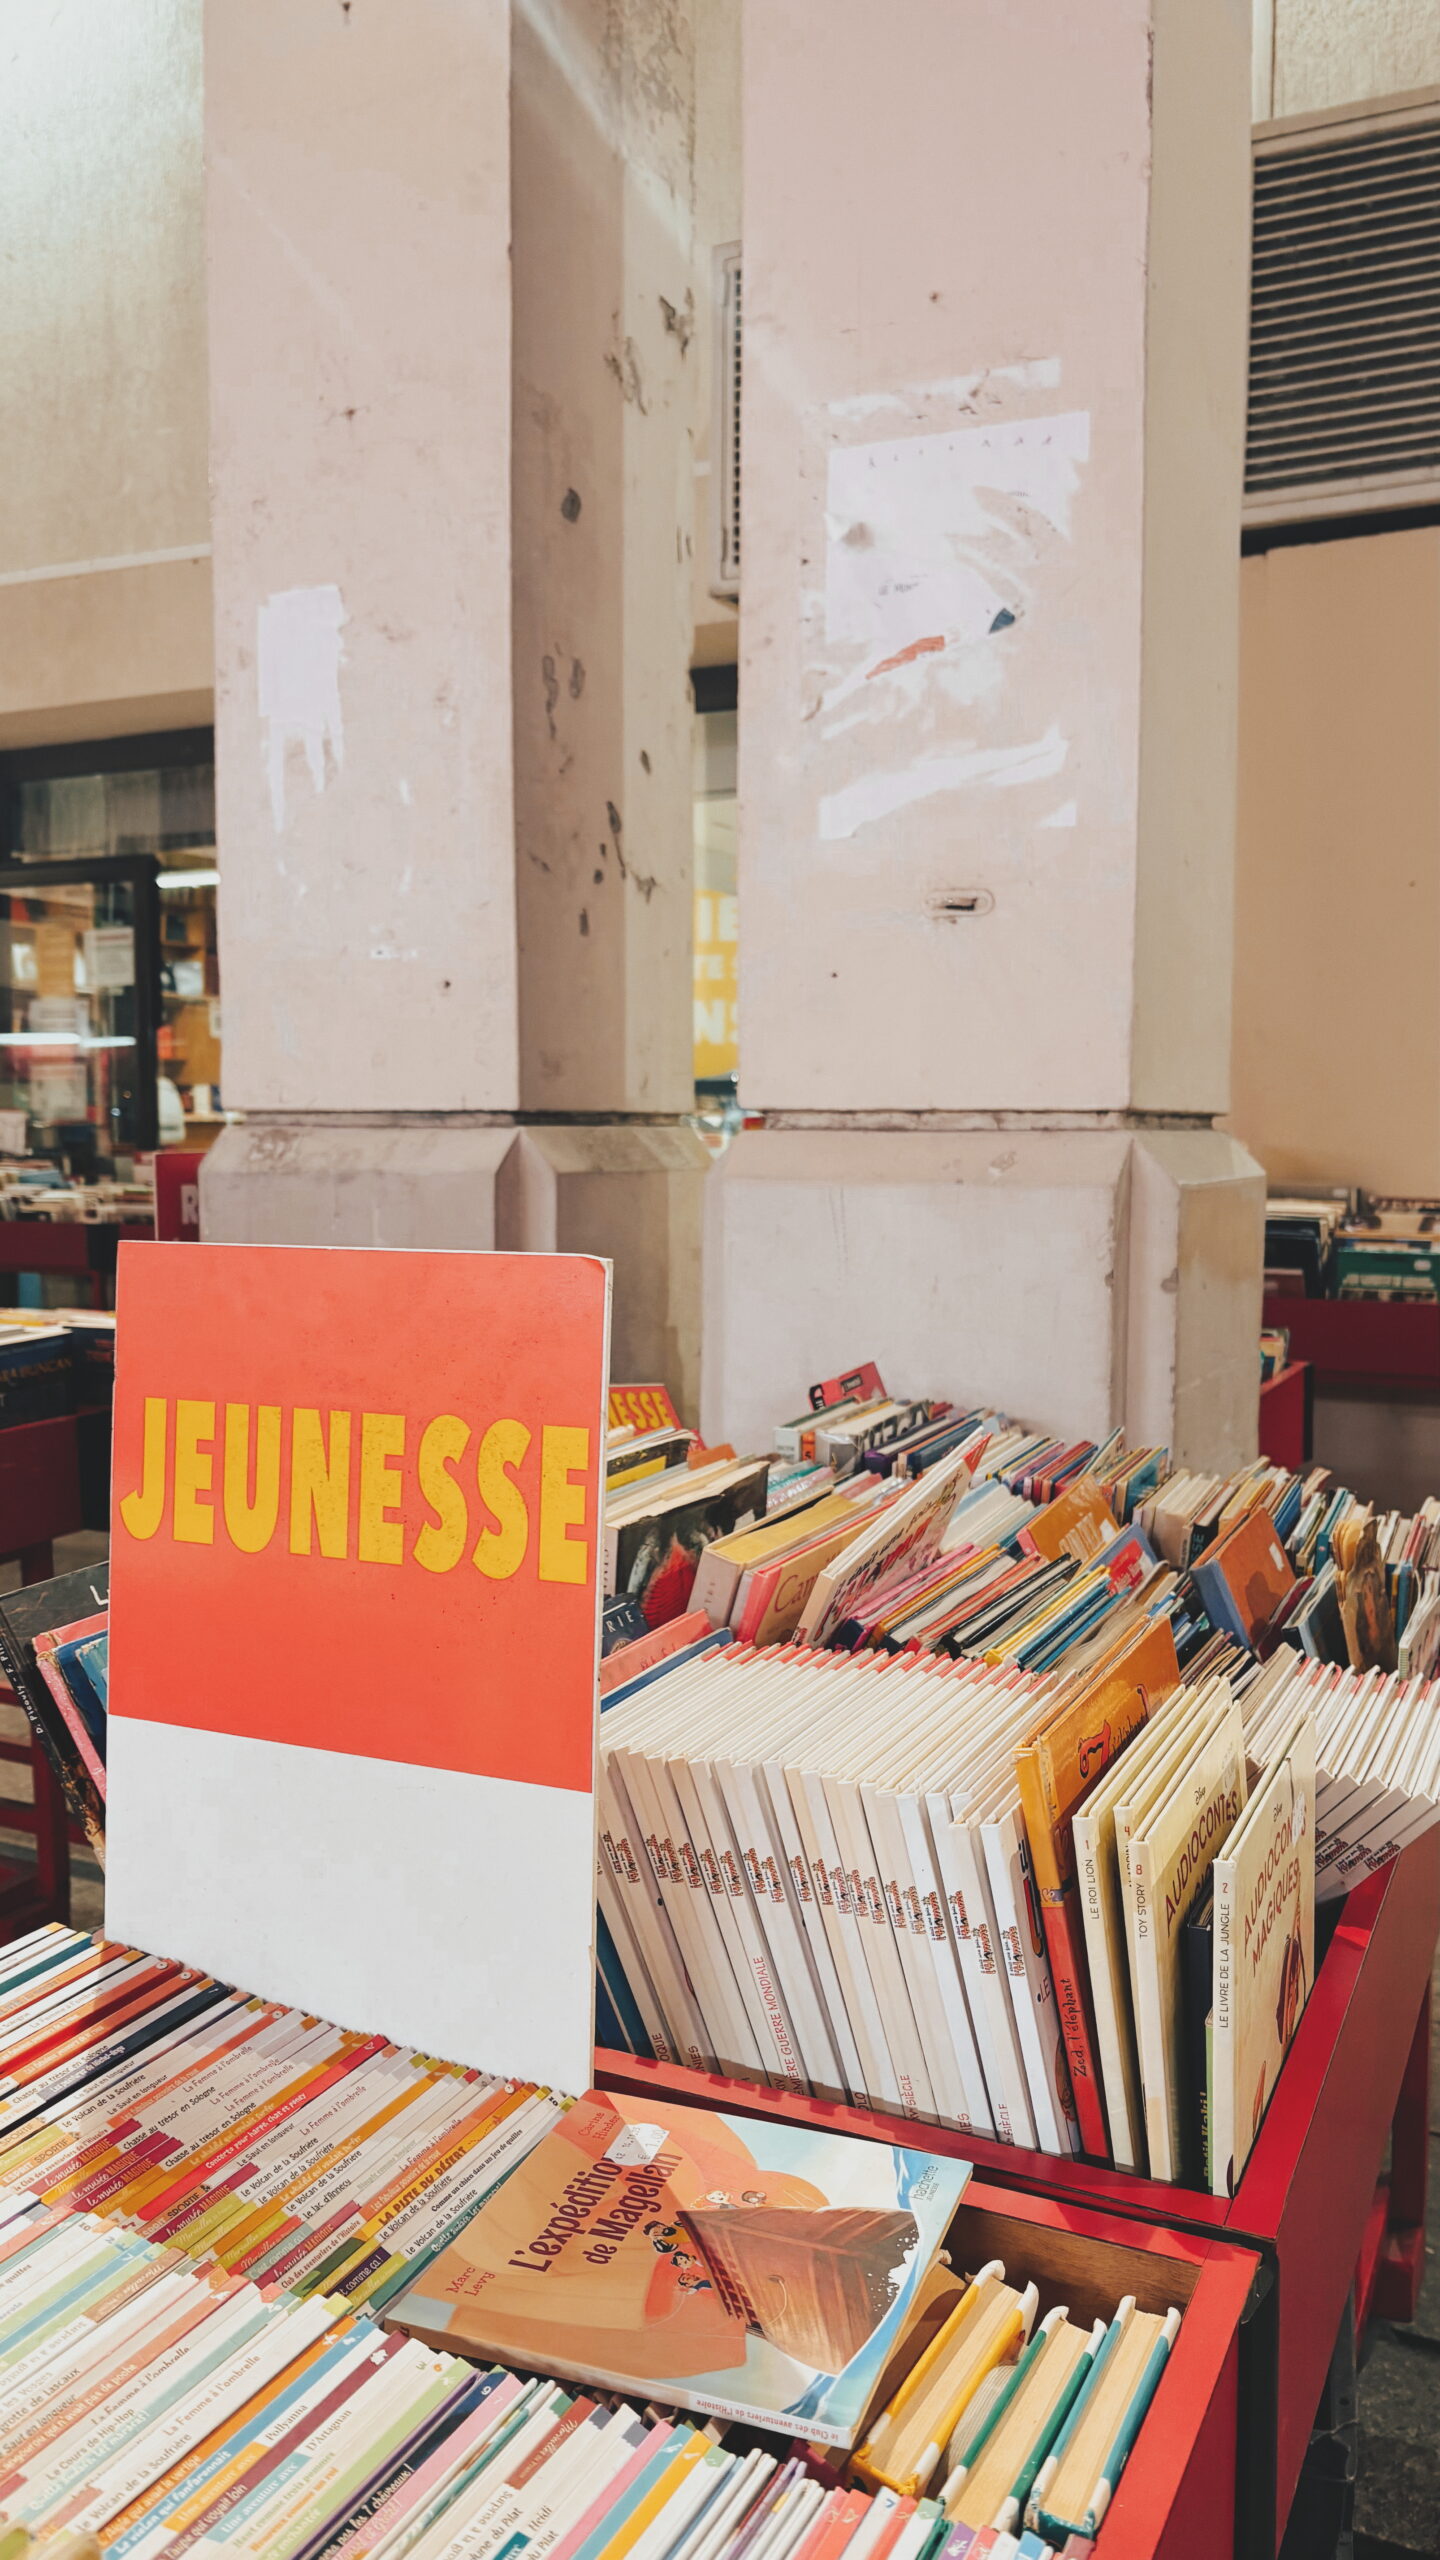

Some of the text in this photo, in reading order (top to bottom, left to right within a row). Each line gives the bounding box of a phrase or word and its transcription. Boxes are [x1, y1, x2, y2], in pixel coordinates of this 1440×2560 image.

[120, 1397, 590, 1585] JEUNESSE
[1085, 1859, 1096, 1883] LION
[1165, 1790, 1238, 1938] AUDIOCONTES
[1244, 1806, 1306, 1957] AUDIOCONS
[1088, 1883, 1099, 1905] ROI
[1091, 1907, 1100, 1920] LE
[1135, 1864, 1148, 1939] TOY STORY 8
[1252, 1857, 1301, 1978] MAGIQUES
[1219, 1882, 1231, 2029] LE LIVRE DE LA JUNGLE 2
[753, 1955, 780, 2011] MONDIALE
[770, 2013, 793, 2056] GUERRE
[182, 2043, 252, 2093] La Femme à l'ombrelle
[61, 2071, 145, 2128] Le Volcan de la Soufrière
[107, 2105, 117, 2115] Le
[116, 2096, 132, 2109] Saut
[140, 2073, 168, 2095] longueur
[164, 2100, 257, 2167] Chasse au trésor en Sologne
[205, 2093, 307, 2169] Concerto pour harpe, chat et poney
[578, 2112, 605, 2137] Carine
[34, 2137, 69, 2163] SPORTIF
[240, 2136, 319, 2197] Le Volcan de la Soufrière
[430, 2127, 524, 2212] Comme un chien dans un jeu de quilles
[94, 2177, 124, 2201] musée
[120, 2157, 154, 2183] MAGIQUE
[302, 2177, 352, 2219] Le lac d'Annecy
[378, 2145, 466, 2226] LA PISTE DU DÉSERT
[588, 2152, 684, 2243] Magellan
[911, 2165, 939, 2201] hachette
[405, 2187, 477, 2255] Le Volcan de la Soufrière
[280, 2218, 360, 2288] Club des aventuriers de l'Histoire
[583, 2243, 618, 2265] de
[445, 2265, 476, 2293] Marc
[464, 2271, 497, 2297] Levy
[28, 2393, 44, 2408] de
[43, 2365, 80, 2396] Lascaux
[163, 2352, 260, 2438] La Femme à l'ombrelle
[697, 2399, 733, 2416] l'Histoire
[46, 2406, 136, 2481] Le Cours de Hip-Hop
[264, 2400, 309, 2444] Pollyanna
[305, 2406, 353, 2453] D'Artagnan
[747, 2413, 793, 2429] aventuriers
[812, 2430, 829, 2440] Club
[477, 2488, 512, 2527] Surprise
